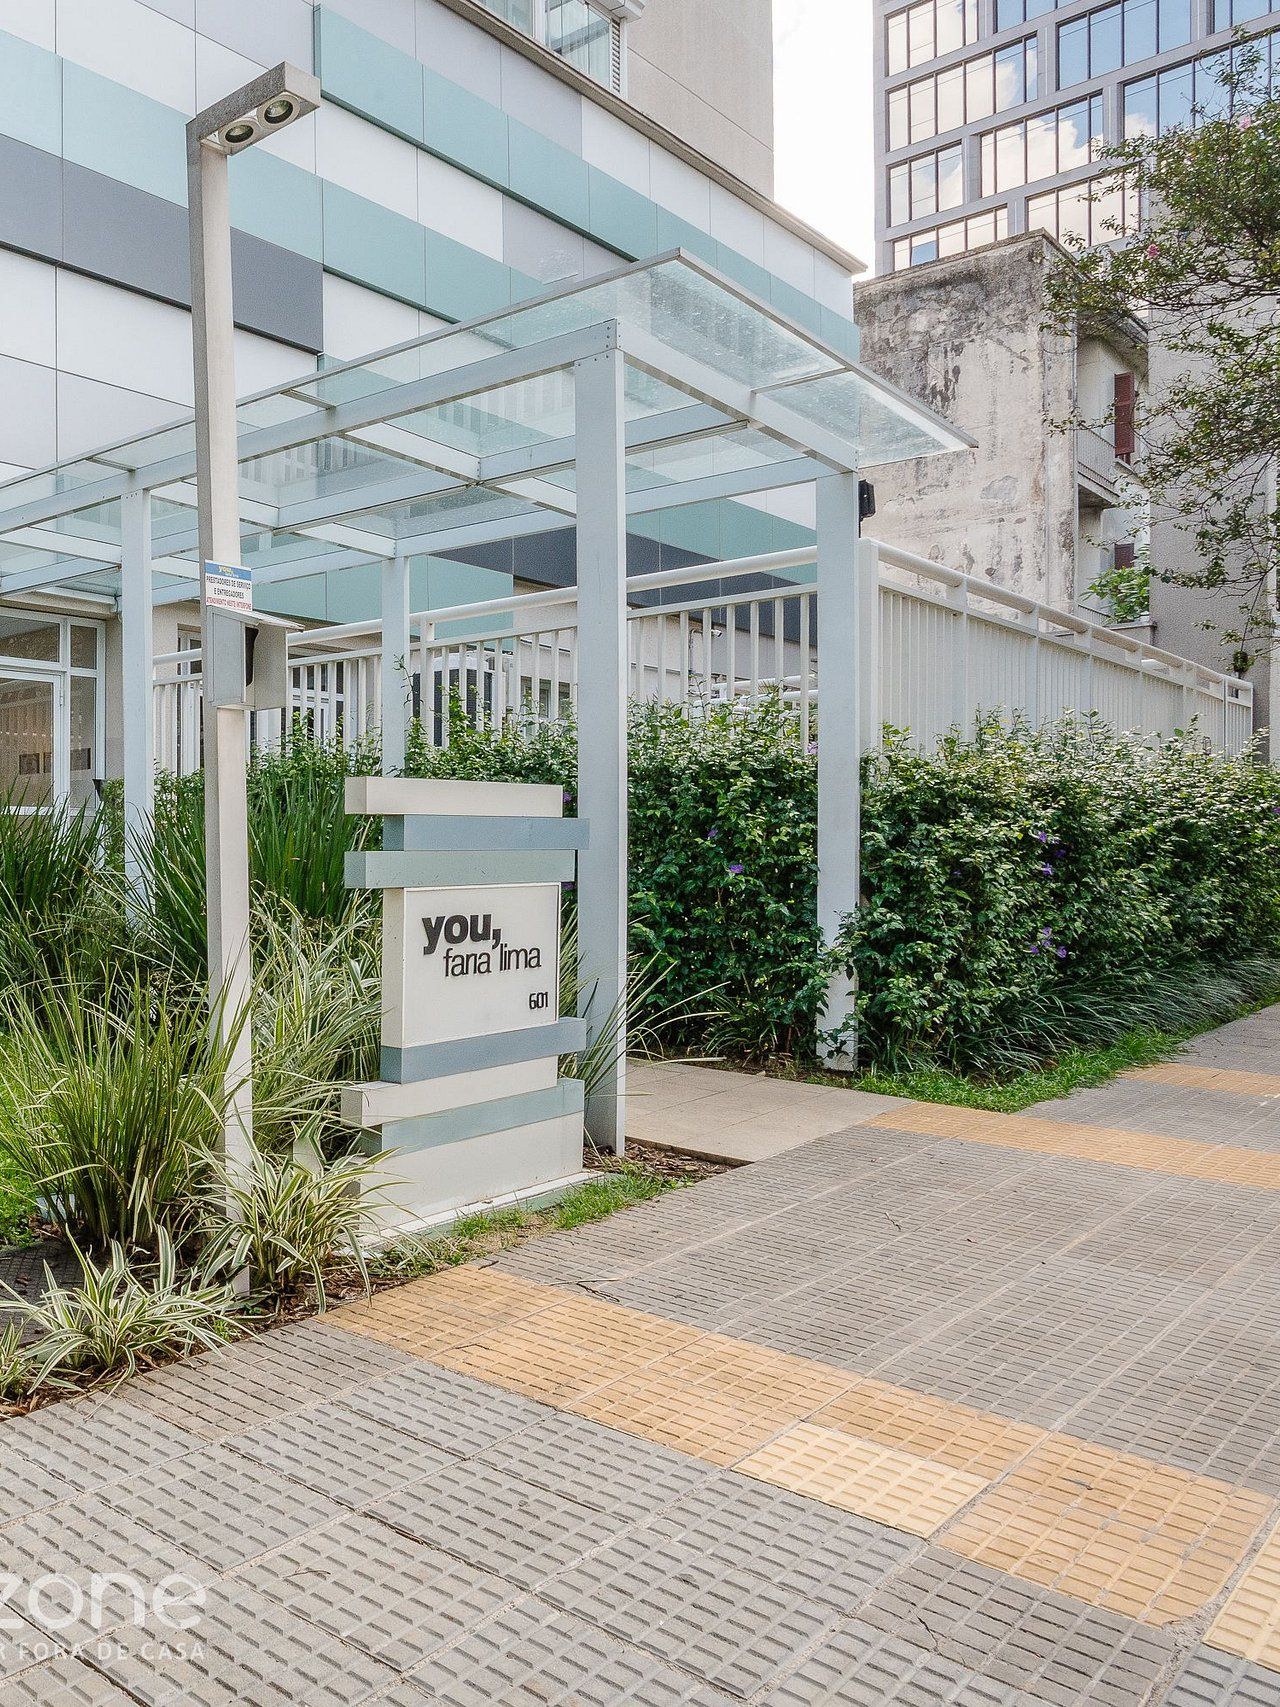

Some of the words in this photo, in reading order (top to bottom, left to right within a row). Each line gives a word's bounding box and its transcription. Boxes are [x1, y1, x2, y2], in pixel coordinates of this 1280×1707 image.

[422, 914, 502, 955] you,
[500, 943, 541, 971] lima
[529, 992, 549, 1010] 601
